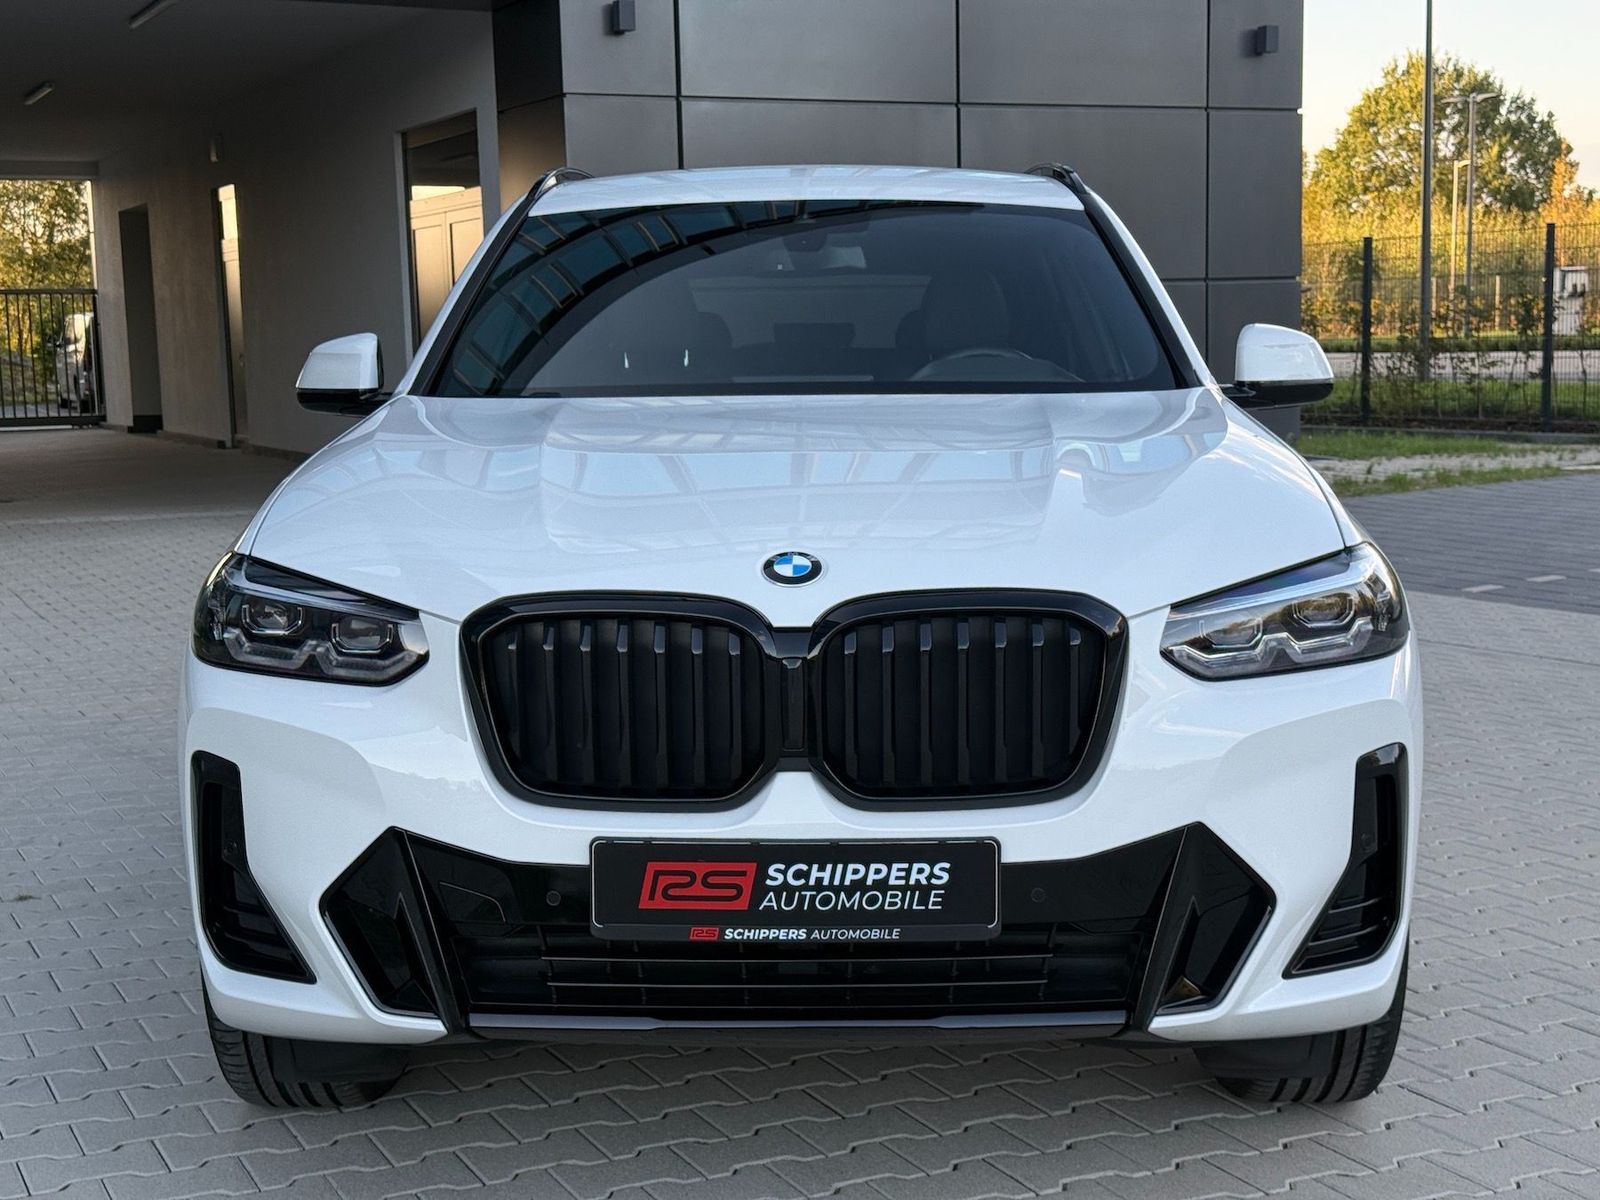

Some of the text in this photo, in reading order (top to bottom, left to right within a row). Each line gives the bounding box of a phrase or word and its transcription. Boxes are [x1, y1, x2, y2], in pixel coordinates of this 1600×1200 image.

[765, 862, 951, 886] SCHIPPERS
[647, 868, 750, 903] RS
[758, 890, 945, 911] AUTOMOBILE
[724, 928, 807, 941] SCHIPPERS
[810, 928, 901, 940] AUTOMOBILE
